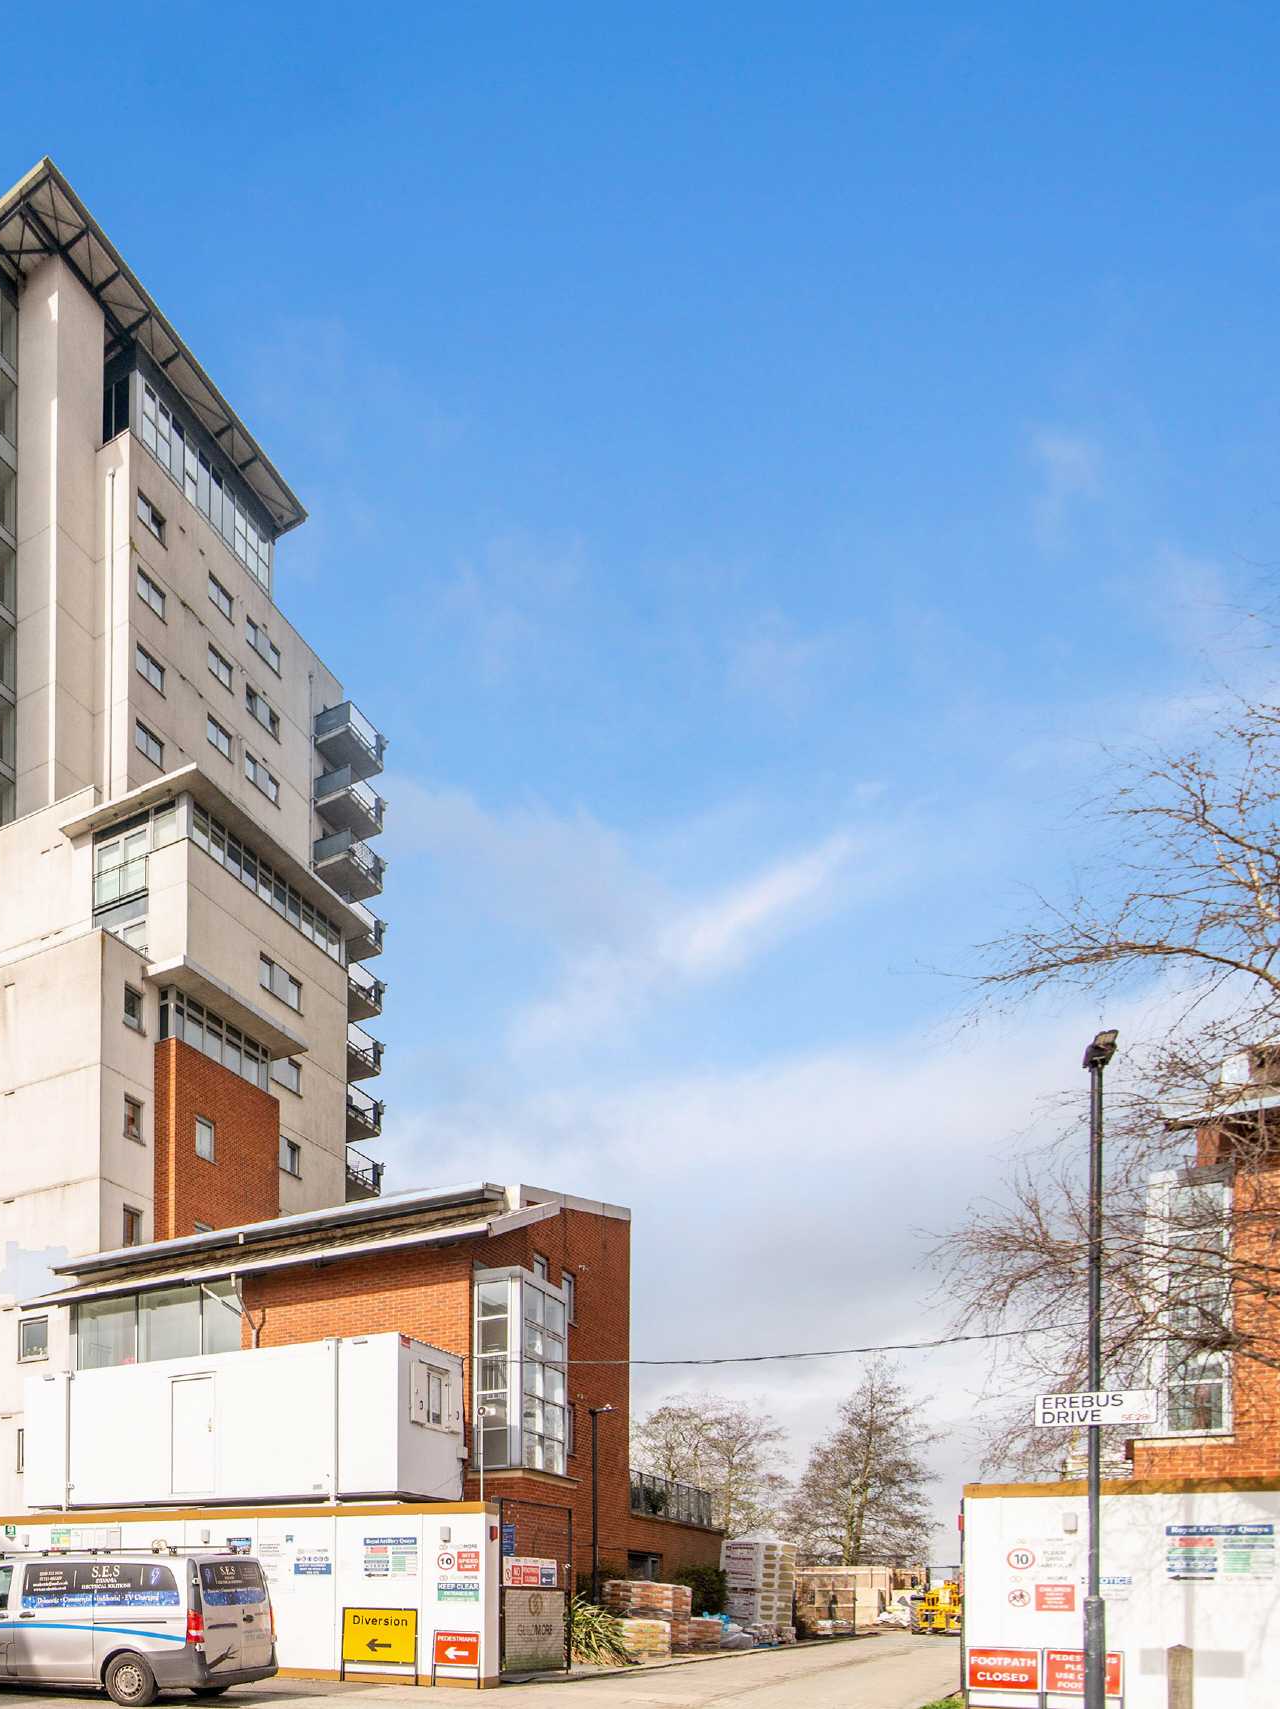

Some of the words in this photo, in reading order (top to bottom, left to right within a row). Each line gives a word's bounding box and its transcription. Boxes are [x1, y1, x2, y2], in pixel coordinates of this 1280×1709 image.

[1042, 1393, 1124, 1410] EREBUS
[1042, 1409, 1102, 1424] DRIVE
[439, 1557, 452, 1566] 10
[1014, 1553, 1029, 1565] 10
[91, 1564, 121, 1578] S.E.S
[352, 1614, 408, 1627] Diversion
[970, 1655, 1037, 1667] FOOTPATH
[976, 1670, 1029, 1683] CLOSED
[1055, 1672, 1075, 1680] USE
